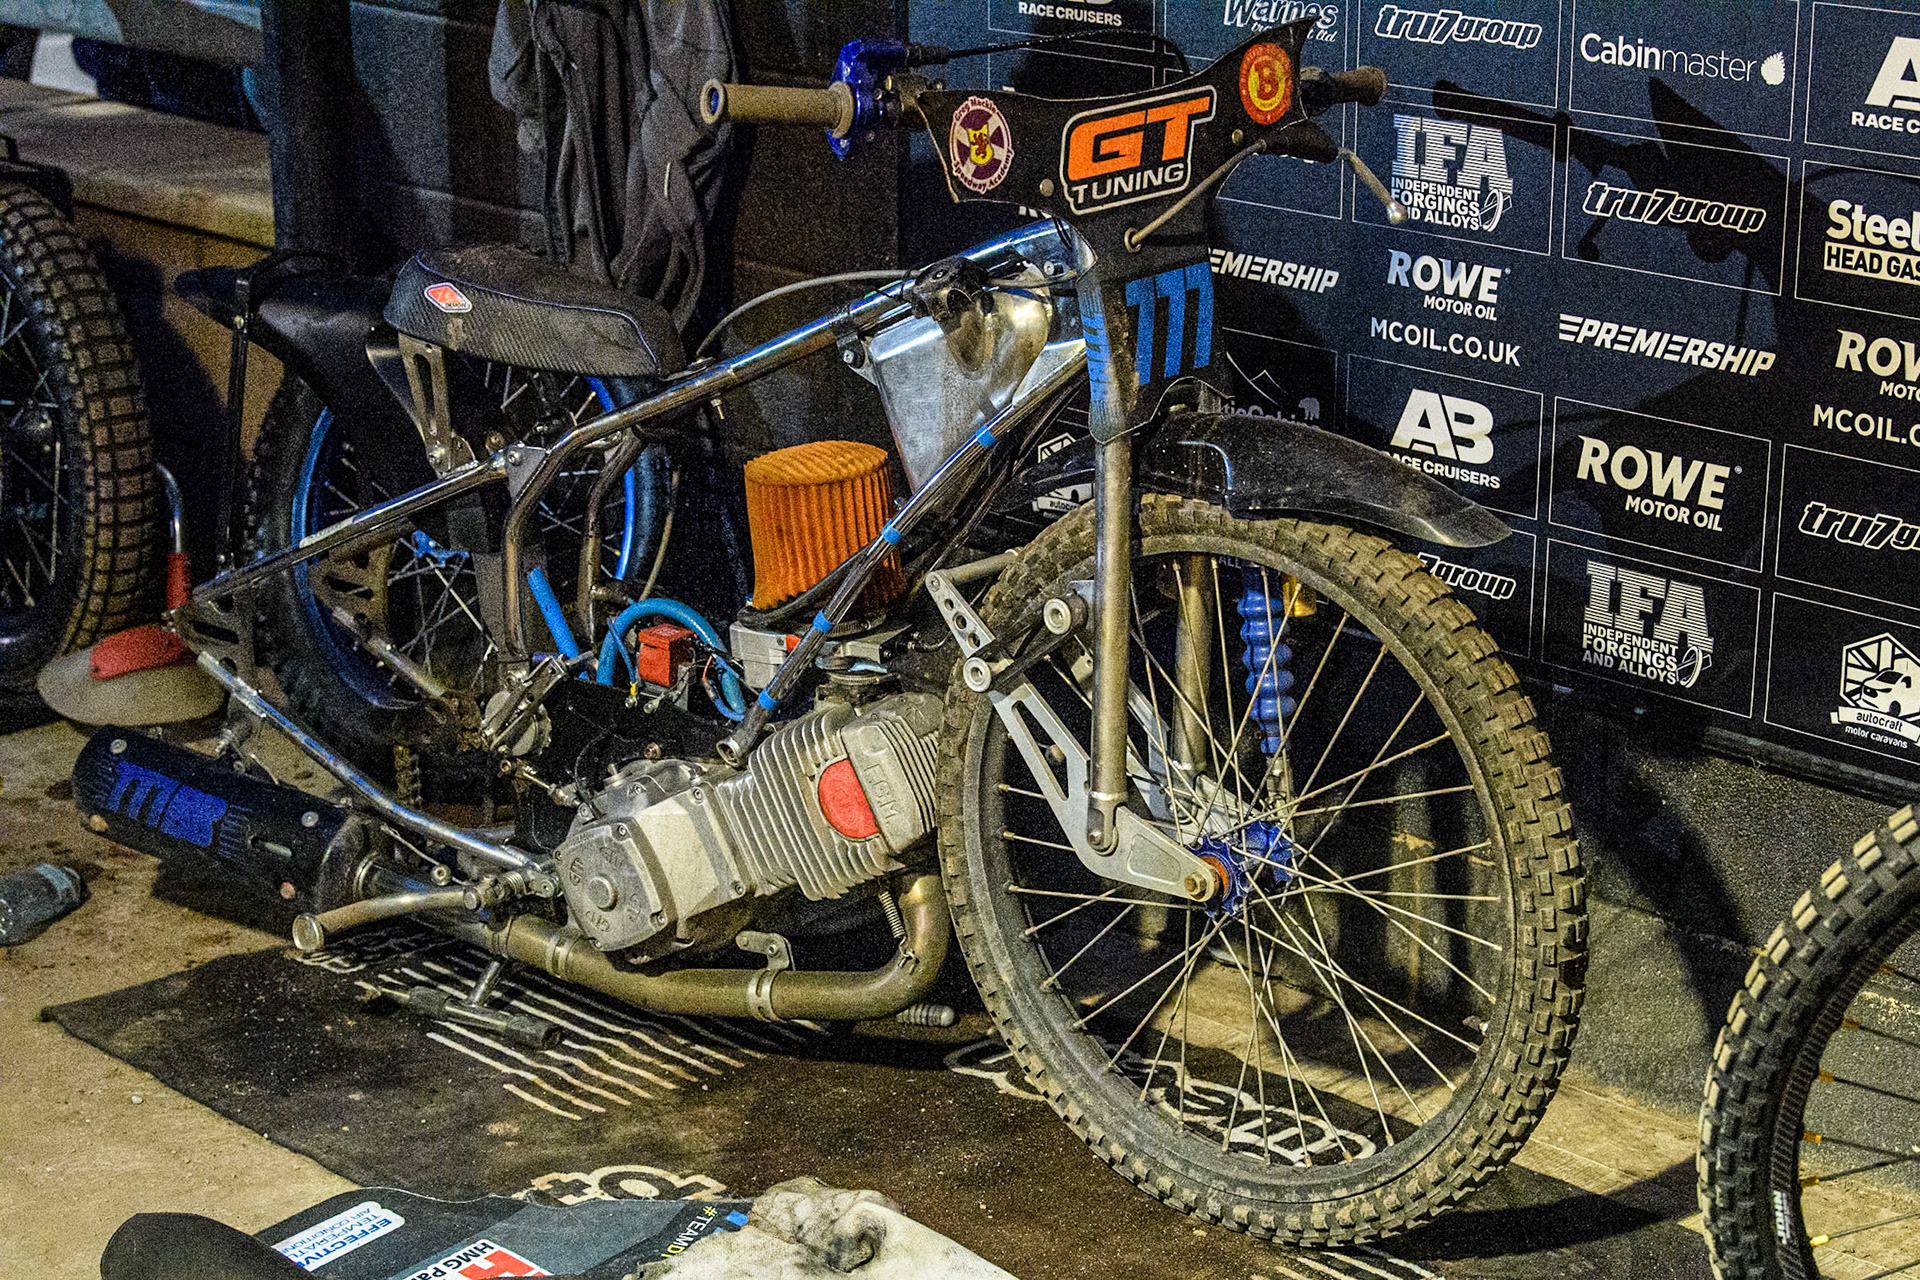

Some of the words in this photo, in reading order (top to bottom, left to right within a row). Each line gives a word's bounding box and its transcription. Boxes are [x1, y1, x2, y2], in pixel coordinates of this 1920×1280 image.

[1018, 2, 1055, 18] RACE
[1056, 7, 1123, 27] CRUISERS
[1375, 5, 1542, 49] tru7group
[1580, 32, 1758, 82] Cabinmaster
[1068, 96, 1211, 181] GT
[1851, 111, 1904, 132] RACE
[953, 161, 987, 193] Speedway
[988, 148, 1014, 188] Academy
[1392, 113, 1513, 194] IFA
[1071, 163, 1184, 204] TUNING
[1391, 177, 1481, 202] INDEPENDENT
[1391, 188, 1480, 217] FORGINGS
[1424, 210, 1480, 231] ALLOYS
[1582, 181, 1767, 233] tru7group
[1209, 247, 1340, 293] EMIERSHIP
[1387, 249, 1502, 303] ROWE
[1827, 246, 1883, 274] HEAD
[1423, 295, 1473, 317] MOTOR
[1474, 305, 1498, 321] OIL
[1371, 317, 1521, 367] MCOIL.CO.UK
[1390, 388, 1494, 465] AB
[1422, 461, 1501, 490] CRUISERS
[1577, 435, 1730, 510] ROWE
[1625, 495, 1690, 525] MOTOR
[1693, 511, 1723, 532] OIL
[1417, 552, 1517, 600] 7group
[1584, 560, 1714, 653] IFA
[1582, 634, 1678, 672] FORGINGS
[1583, 622, 1678, 656] INDEPENDENT
[1582, 650, 1614, 669] AND
[1618, 659, 1677, 685] ALLOYS
[1845, 725, 1869, 738] motor
[1870, 732, 1908, 749] caravans
[1856, 712, 1903, 732] autocraft
[351, 1207, 371, 1218] AIR
[443, 1241, 495, 1270] HMG
